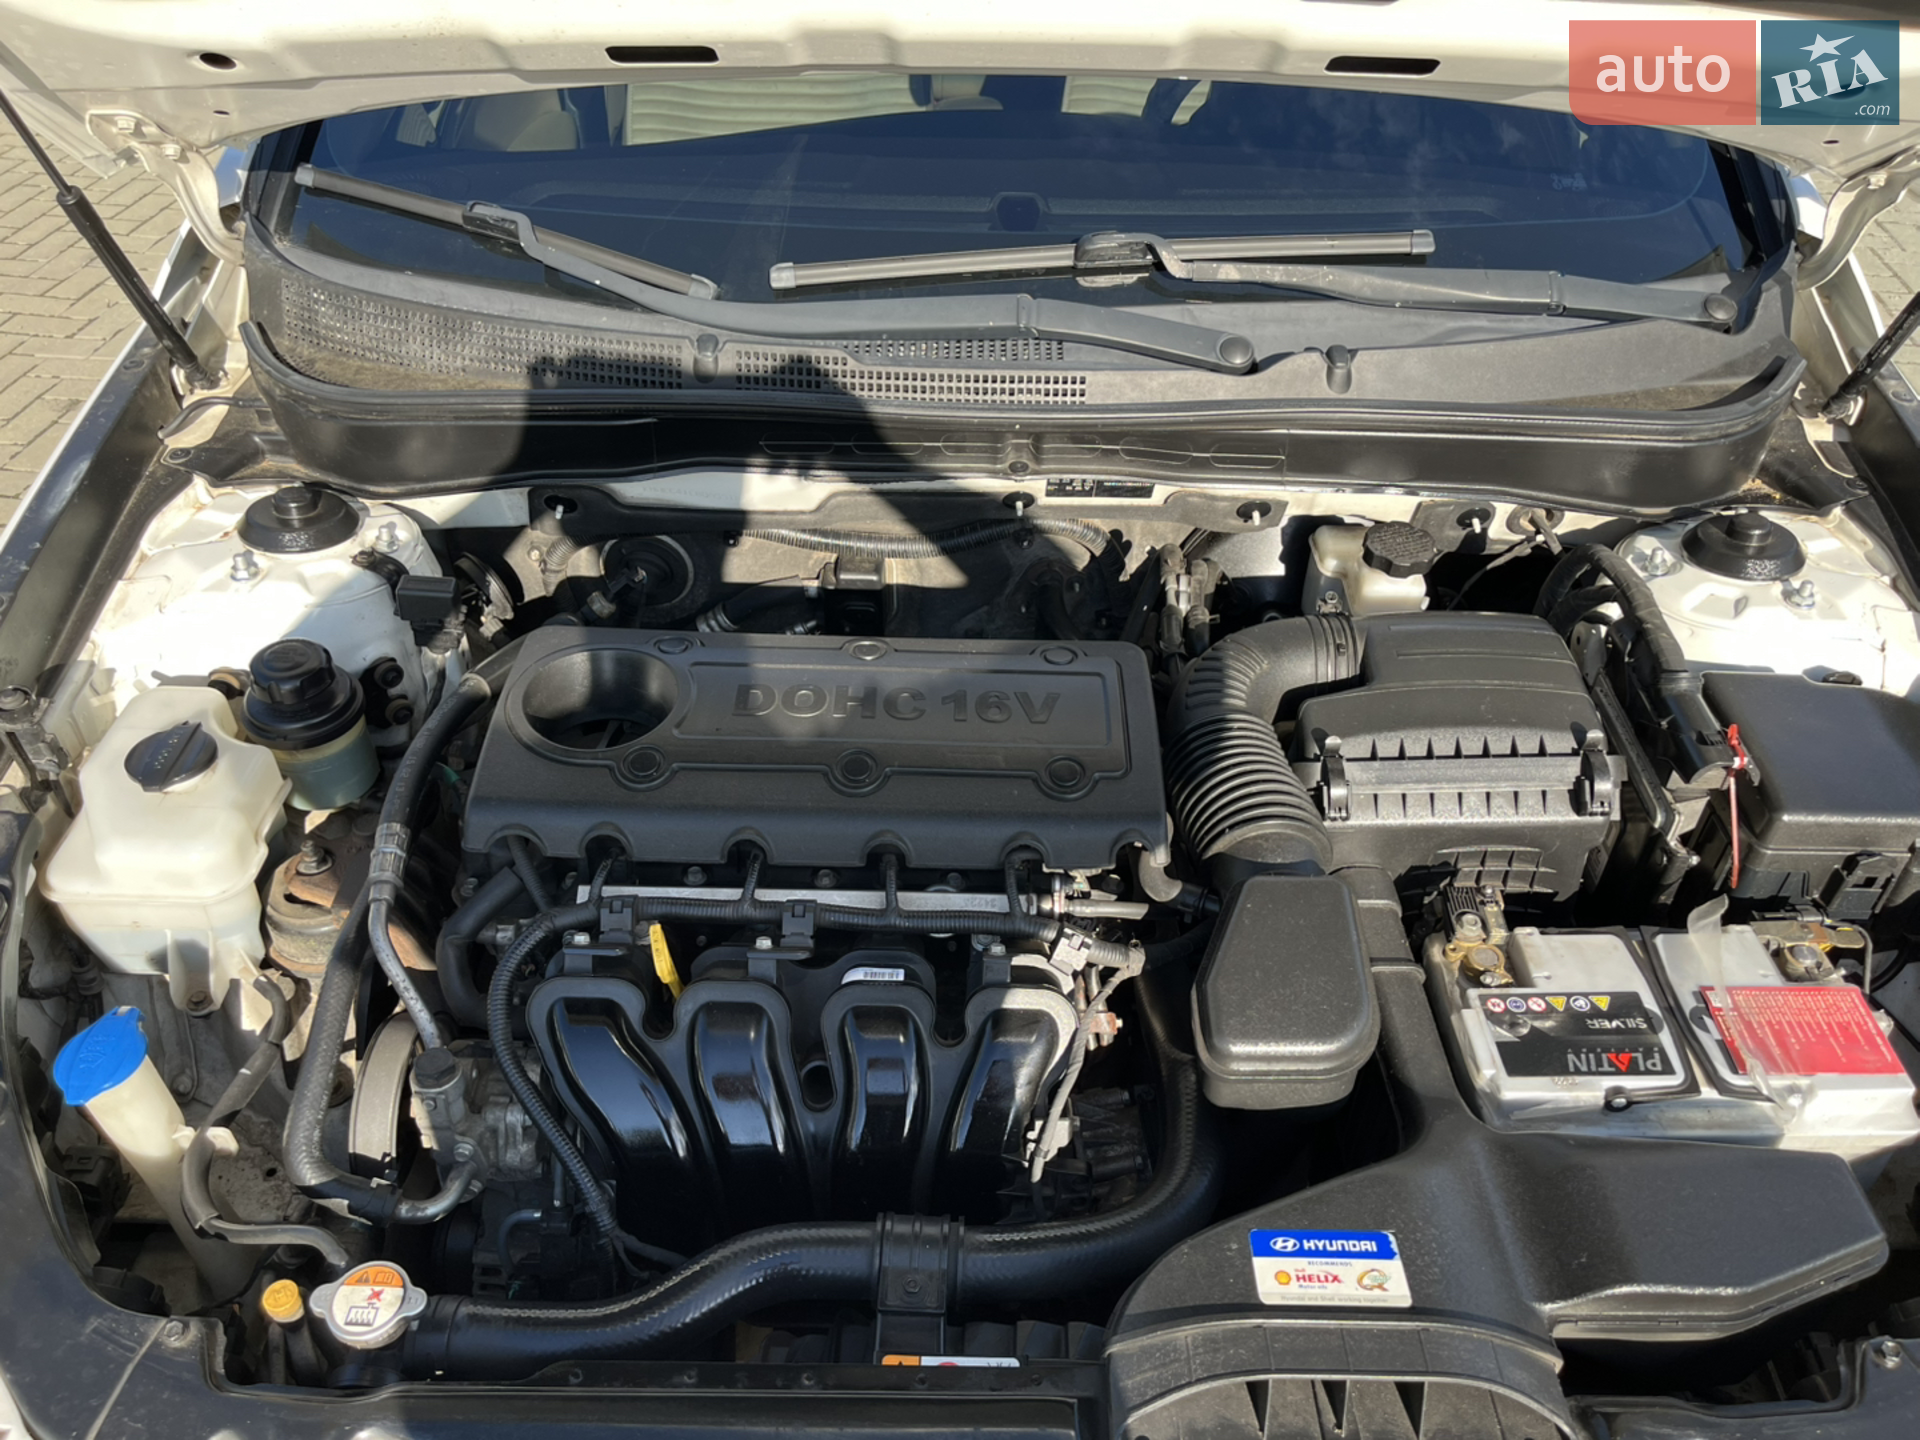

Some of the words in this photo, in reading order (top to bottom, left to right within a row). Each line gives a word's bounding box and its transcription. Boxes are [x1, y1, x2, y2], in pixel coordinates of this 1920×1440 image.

[732, 683, 927, 720] DOHC
[941, 689, 1061, 724] 16V
[1585, 1017, 1647, 1029] SILVER
[1566, 1052, 1663, 1073] PLATIN
[1303, 1239, 1378, 1253] HYUNDAI
[1295, 1273, 1342, 1284] HELIX
